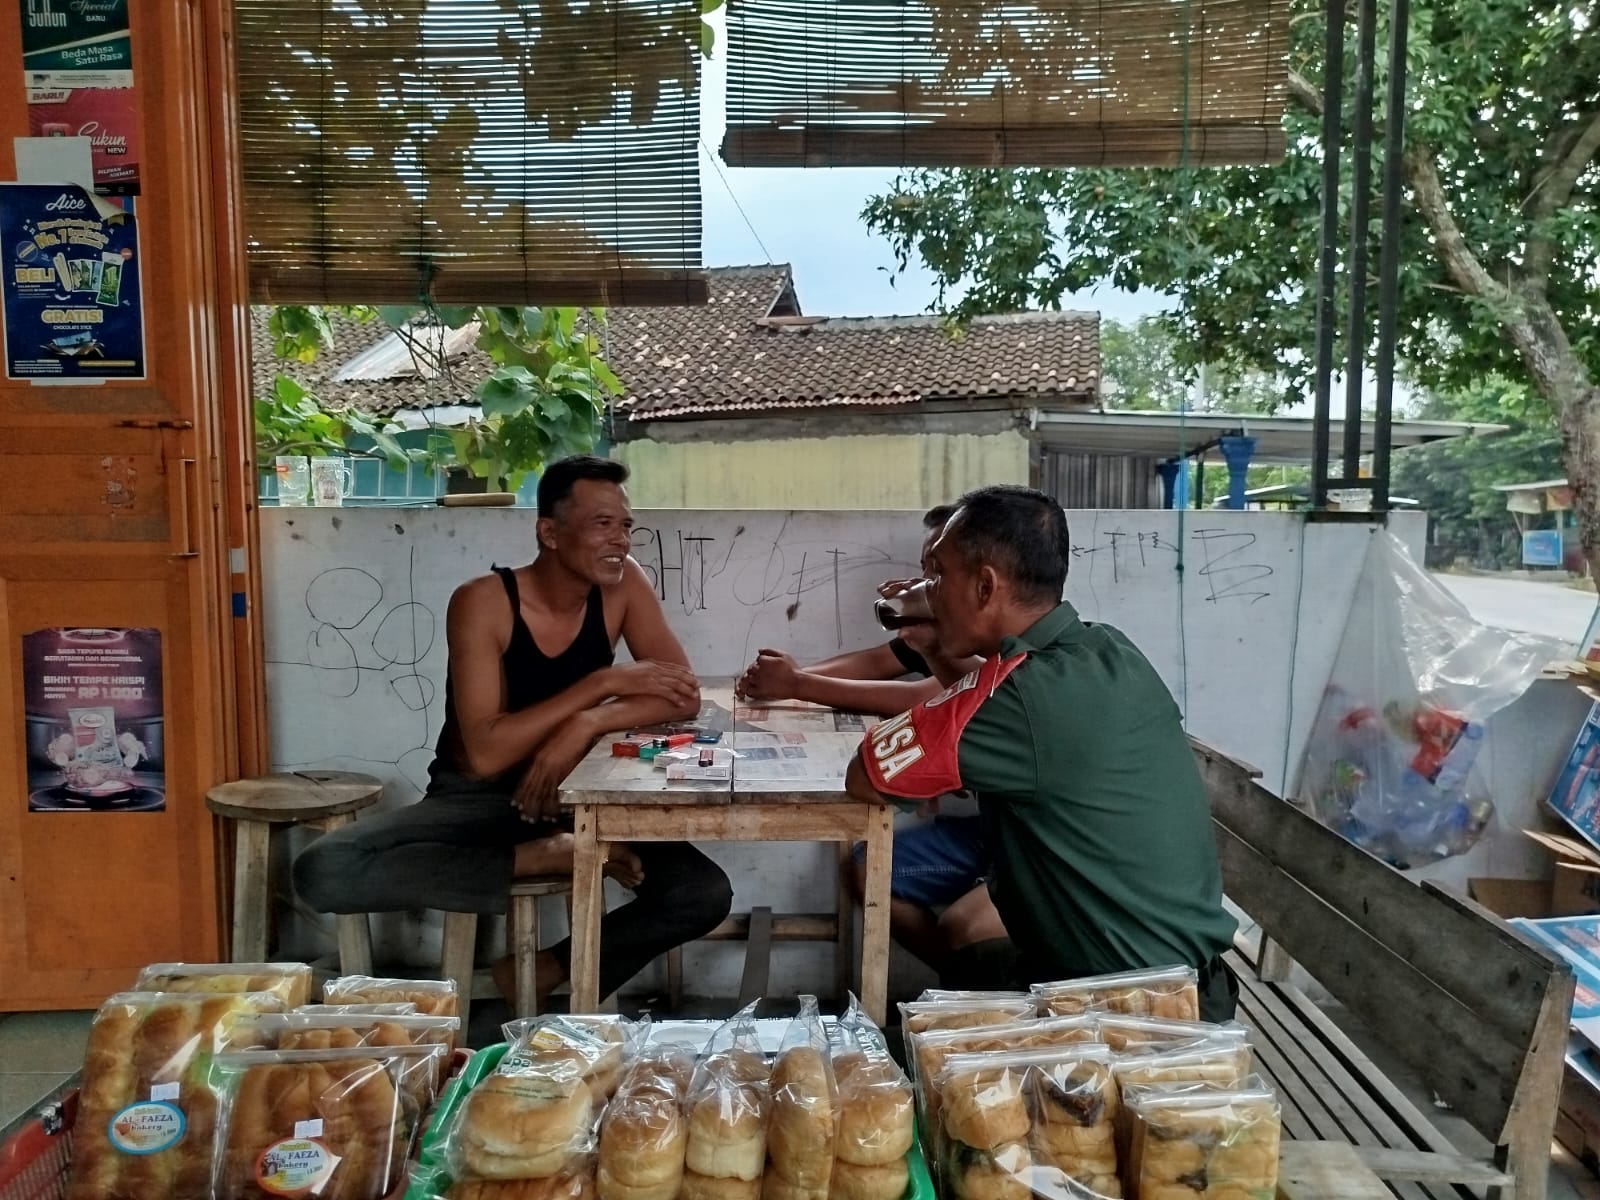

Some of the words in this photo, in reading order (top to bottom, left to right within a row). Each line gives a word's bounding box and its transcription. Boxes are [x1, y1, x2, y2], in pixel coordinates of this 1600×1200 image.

[61, 48, 87, 59] Beda
[87, 46, 114, 56] Masa
[75, 57, 98, 66] Satu
[100, 53, 123, 62] Rasa
[45, 193, 87, 211] Aice
[15, 267, 55, 283] BELI
[43, 675, 71, 684] BIKIN
[72, 675, 109, 684] TEMPE
[111, 676, 145, 684] KRISPI
[78, 687, 100, 699] RP
